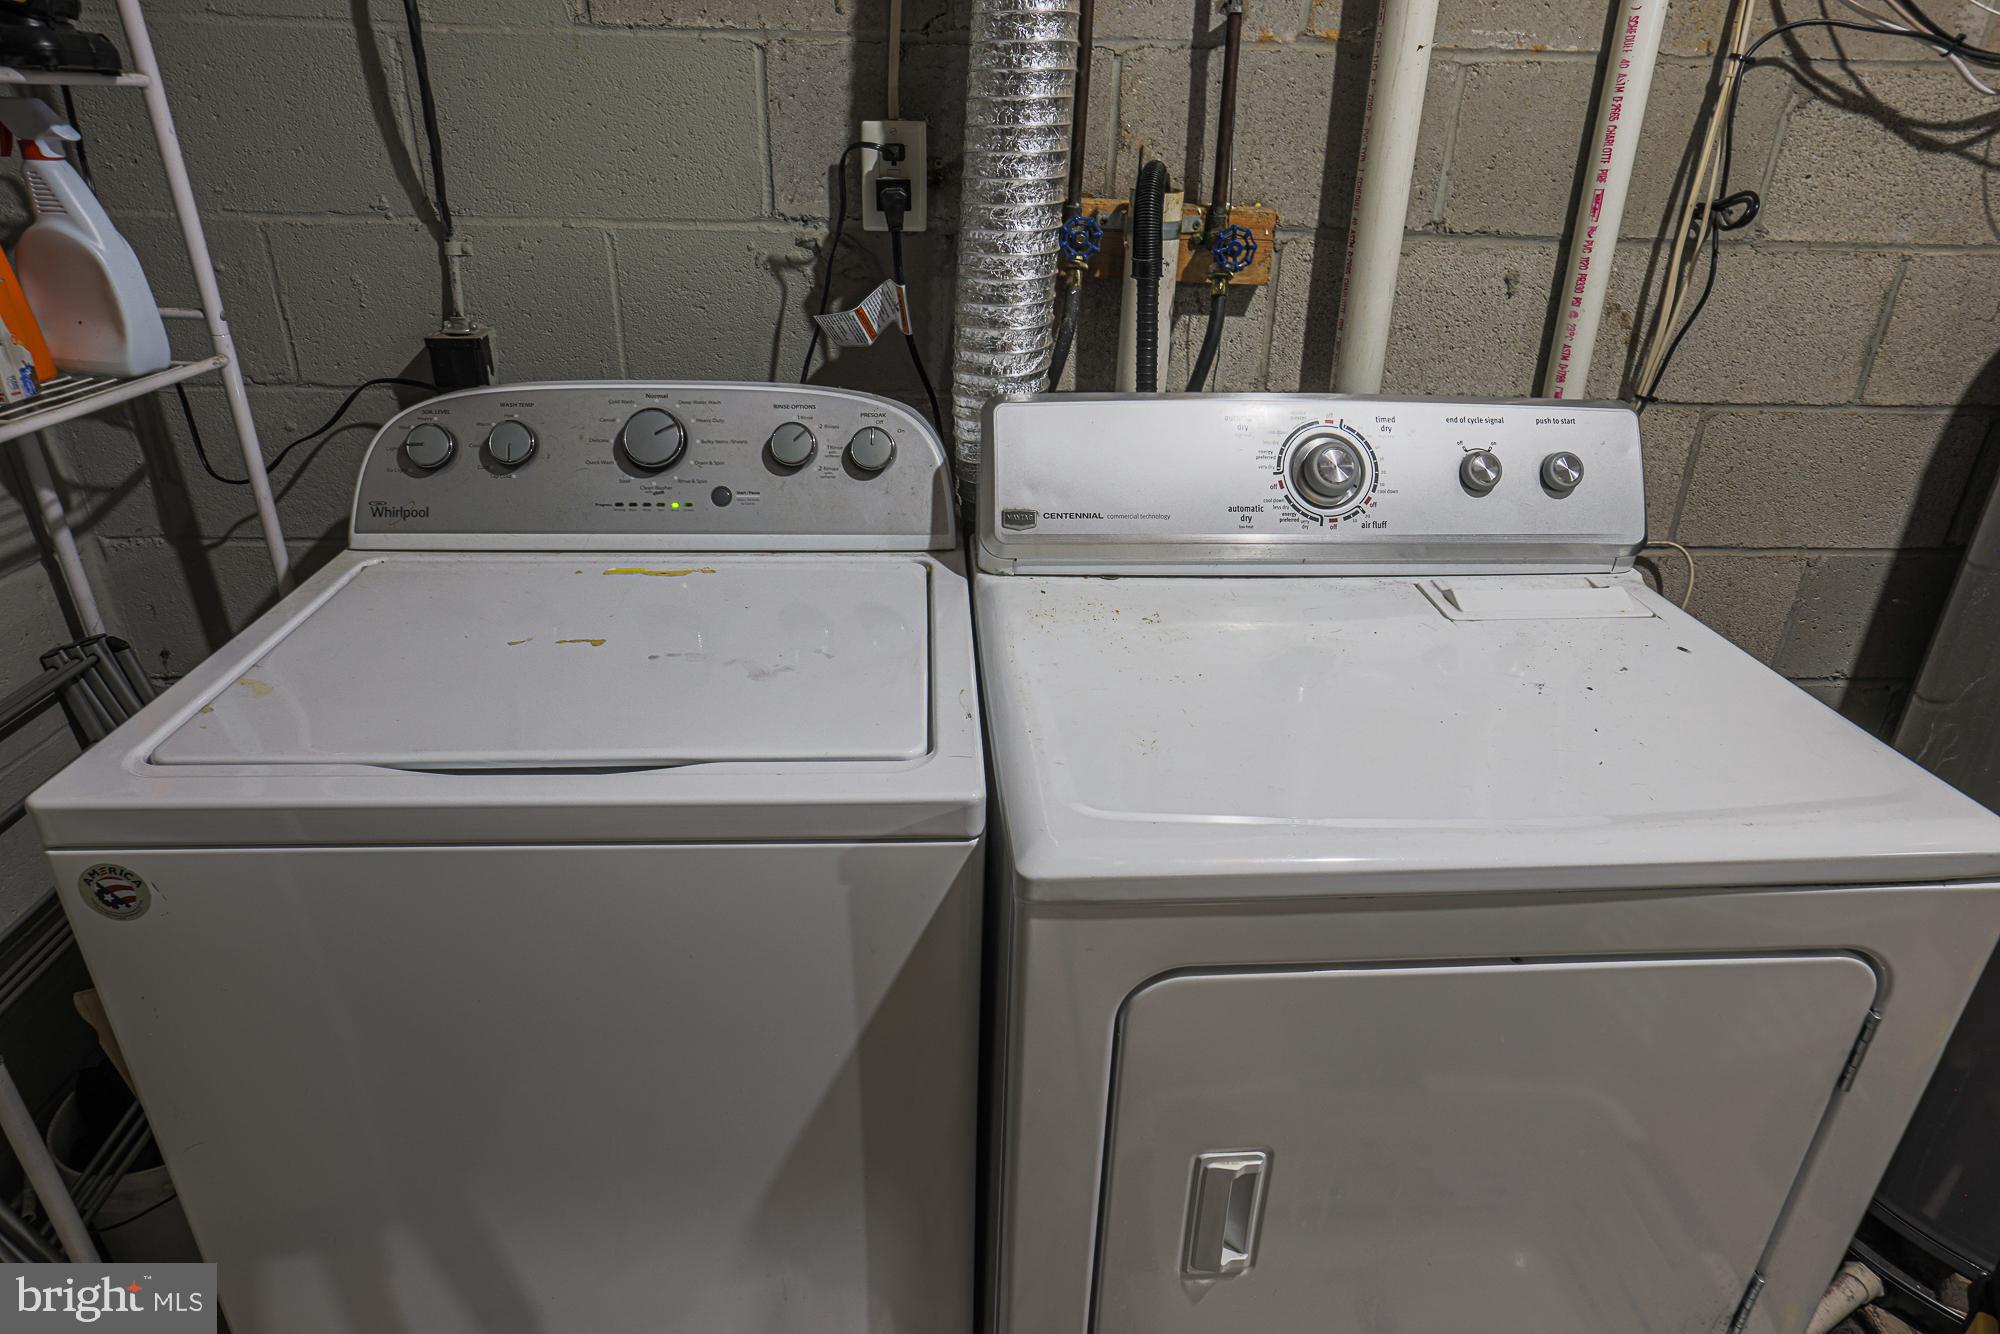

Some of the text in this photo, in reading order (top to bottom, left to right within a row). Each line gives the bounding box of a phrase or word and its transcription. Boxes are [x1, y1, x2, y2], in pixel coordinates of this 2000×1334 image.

[1623, 16, 1641, 52] SCHEDULE
[1619, 58, 1630, 69] 40
[1616, 72, 1628, 93] ASTM
[1600, 124, 1618, 163] CHARLOTTE
[1583, 239, 1595, 254] PVC
[1562, 344, 1572, 361] ASTM
[1467, 416, 1484, 425] cycle
[1484, 416, 1505, 425] signal
[1535, 417, 1552, 426] push
[1552, 417, 1560, 425] to
[1380, 425, 1392, 434] dry
[370, 506, 429, 521] Whirlpool
[1227, 504, 1264, 513] automatic
[1007, 513, 1034, 521] MAYTAG
[1043, 512, 1104, 520] CENTENNIAL
[1140, 513, 1171, 522] technology
[1240, 514, 1253, 523] dry
[1361, 521, 1388, 529] air fluff
[83, 866, 142, 888] AMERICA
